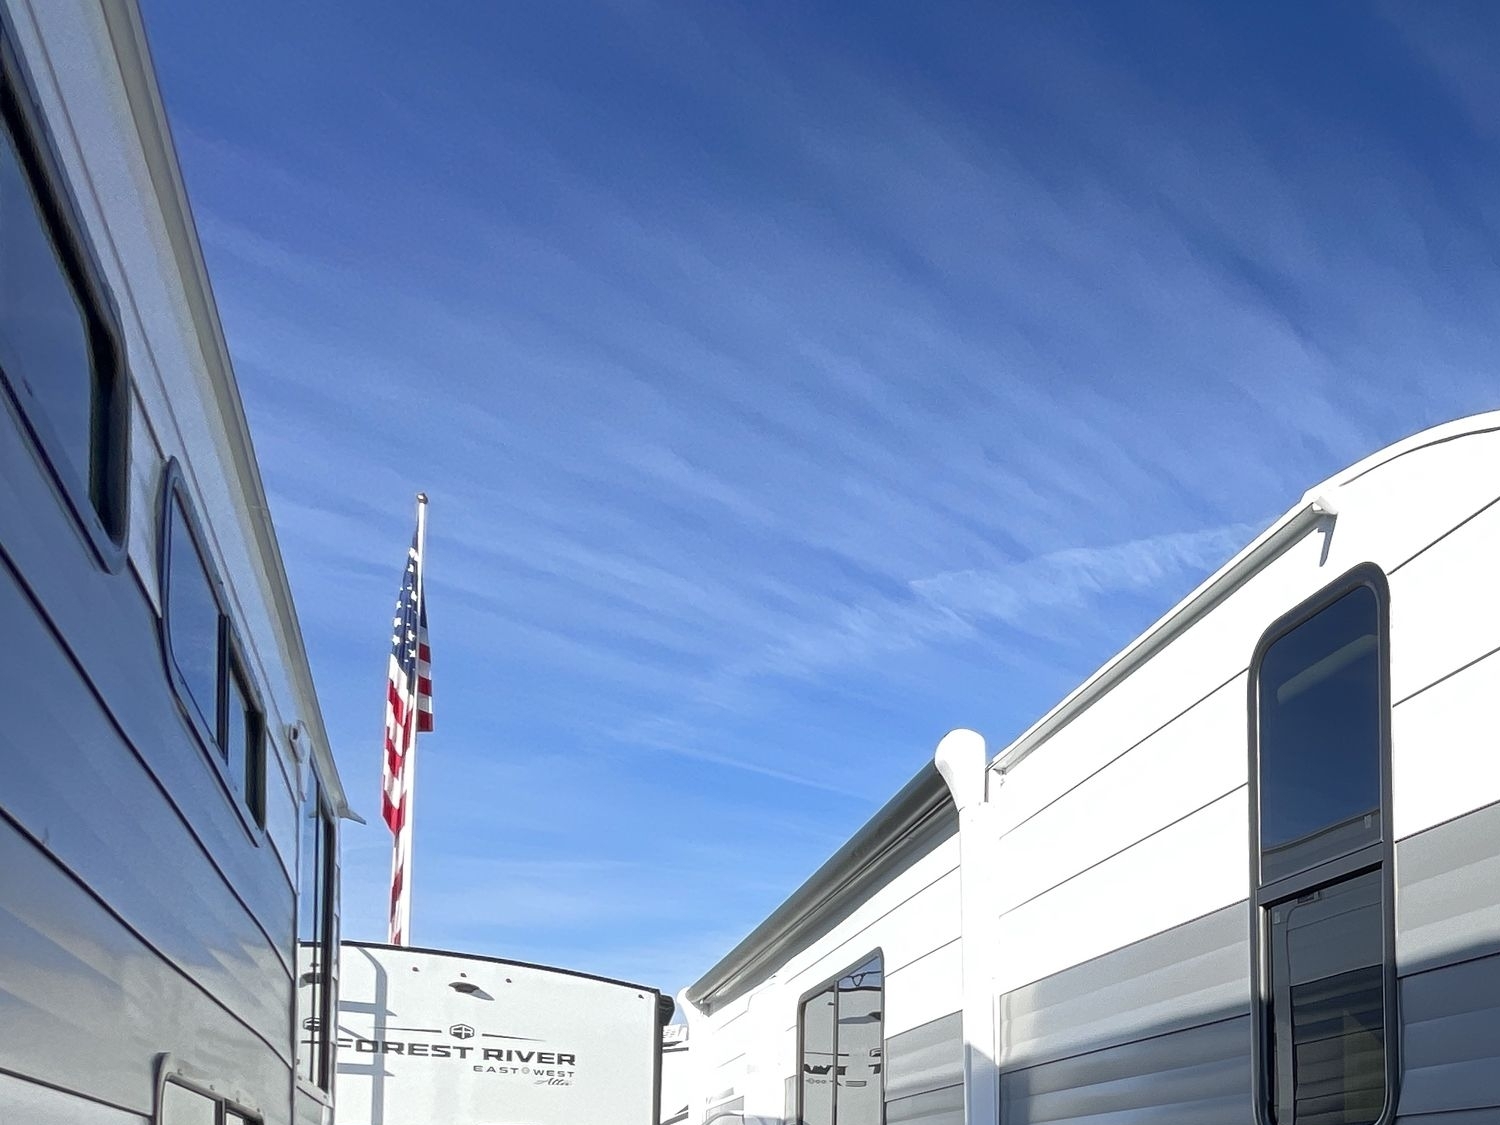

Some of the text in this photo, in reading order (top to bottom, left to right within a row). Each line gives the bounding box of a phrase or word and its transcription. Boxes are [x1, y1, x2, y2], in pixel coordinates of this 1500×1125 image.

[482, 1048, 576, 1066] RIVER
[473, 1065, 575, 1078] EAST WEST
